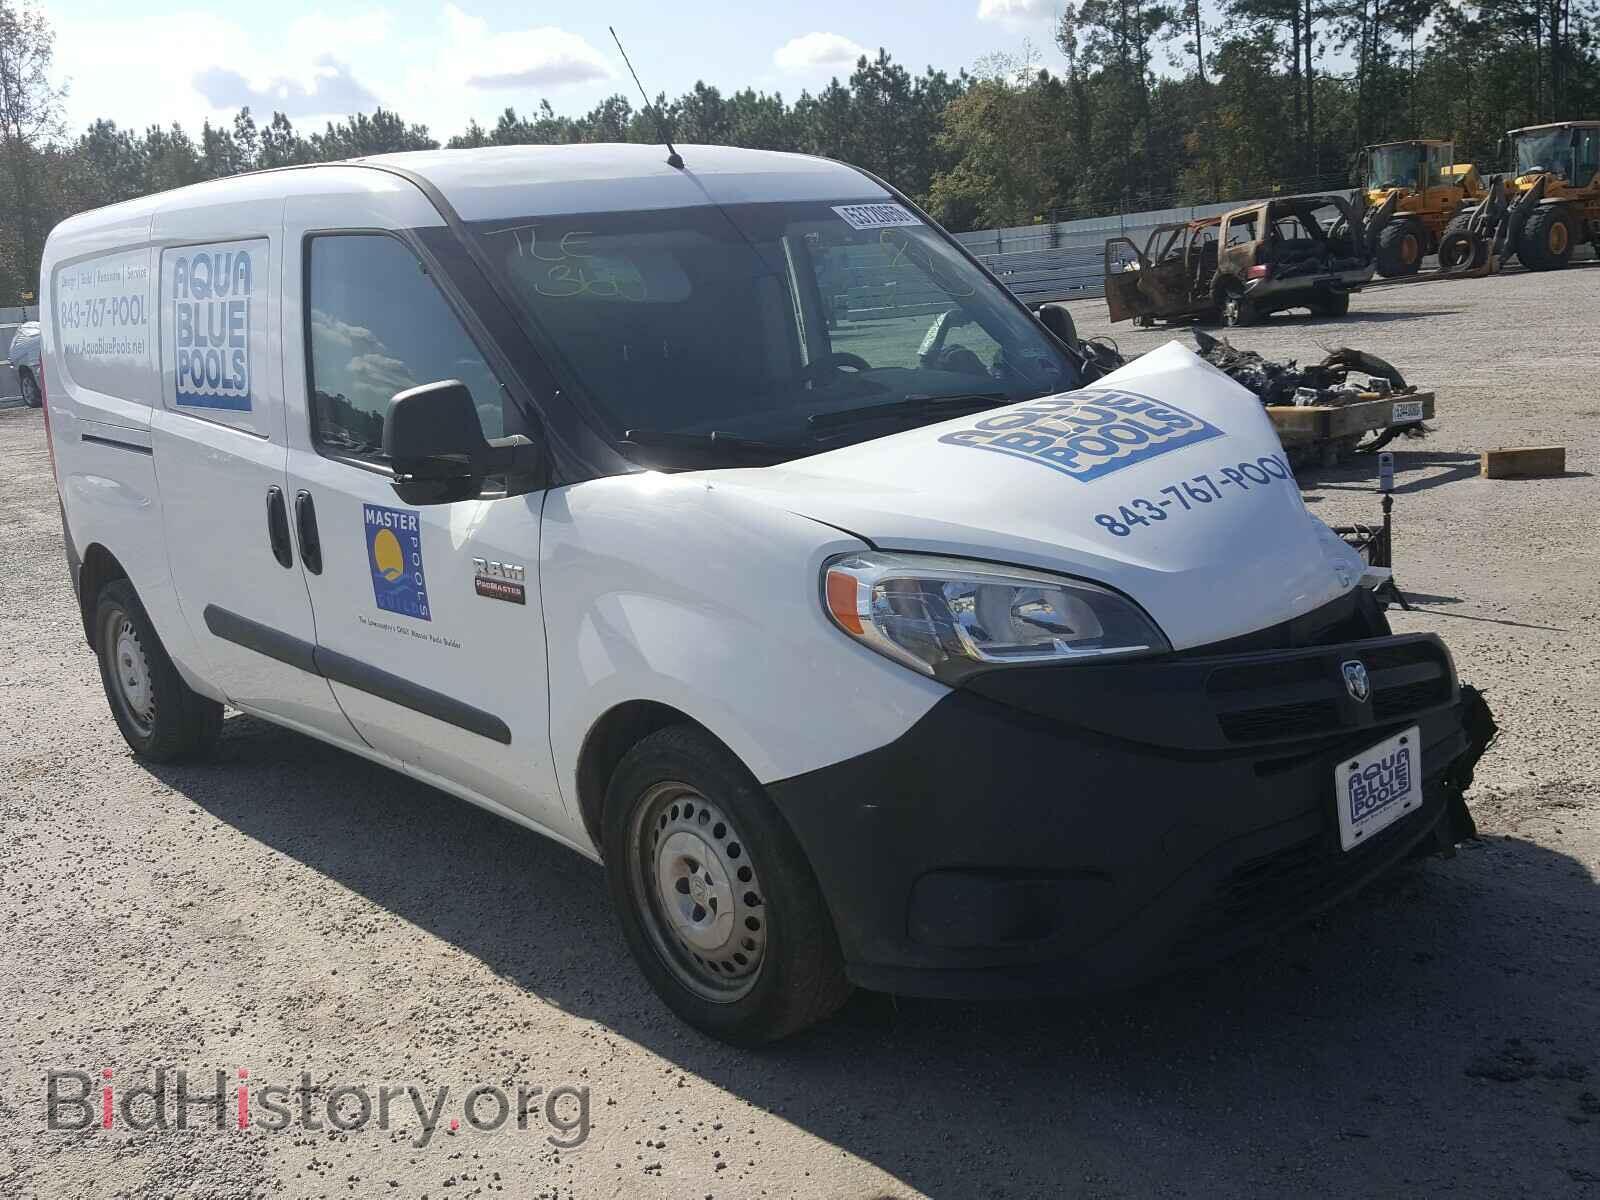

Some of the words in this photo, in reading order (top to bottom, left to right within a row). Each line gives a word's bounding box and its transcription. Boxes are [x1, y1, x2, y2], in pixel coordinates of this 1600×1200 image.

[175, 250, 252, 299] AQUA
[61, 295, 147, 329] 843-767-POOL
[176, 300, 248, 348] BLUE
[178, 349, 247, 390] POOLS
[992, 393, 1155, 453] BLUE
[1034, 408, 1194, 467] POOLS
[365, 508, 418, 532] MASTER
[410, 535, 428, 617] POOLS
[471, 557, 526, 581] RAM
[1348, 748, 1410, 790] AQUA
[1353, 762, 1407, 802] BLUE
[1354, 772, 1408, 817] POOLS
